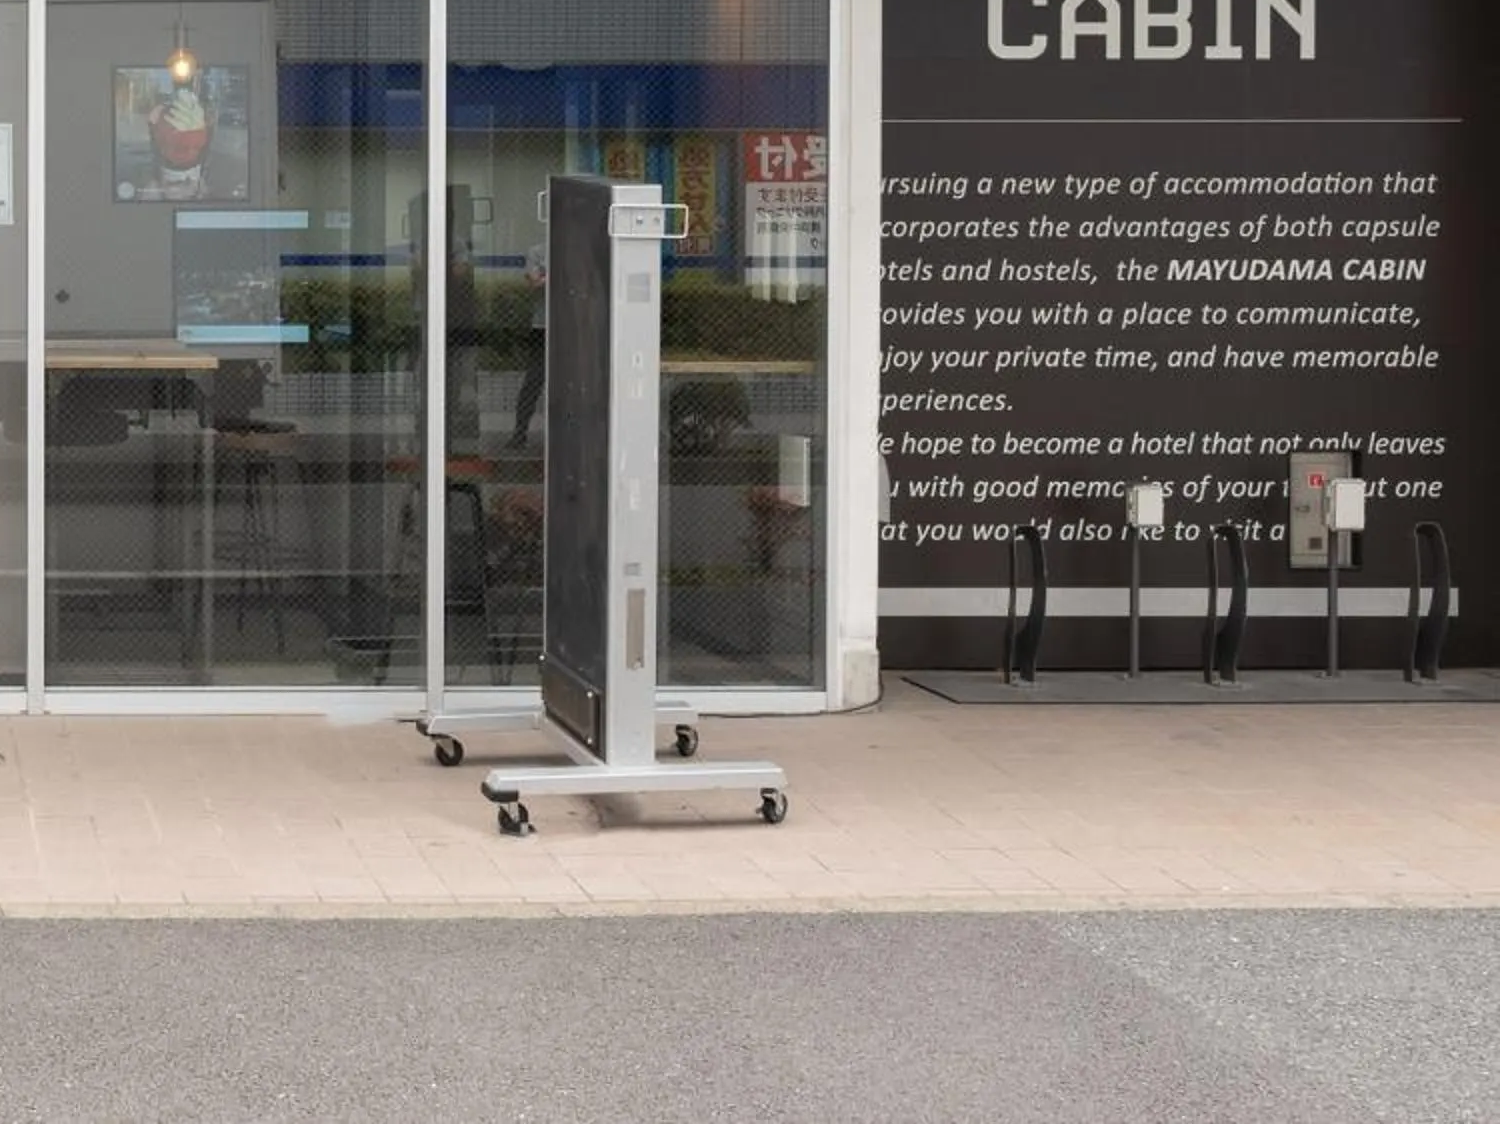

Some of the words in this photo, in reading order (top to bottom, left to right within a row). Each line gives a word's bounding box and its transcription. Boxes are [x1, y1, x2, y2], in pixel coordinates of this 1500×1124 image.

[881, 173, 968, 200] rsuing
[978, 178, 992, 195] a
[1002, 178, 1057, 195] new
[1065, 175, 1121, 200] type
[1130, 172, 1159, 200] of
[1164, 172, 1373, 195] accommodation
[1383, 172, 1437, 195] that
[881, 217, 1019, 242] corporates
[1029, 215, 1070, 238] the
[1079, 215, 1231, 242] advantages
[1239, 215, 1268, 242] of
[1273, 215, 1332, 238] both
[1342, 215, 1441, 242] capsule
[880, 258, 933, 282] tels
[942, 258, 991, 282] and
[1000, 258, 1098, 284] hostels,
[1117, 258, 1159, 282] the
[1166, 259, 1333, 282] MAYUDAMA
[1343, 259, 1427, 282] CABIN
[881, 302, 966, 325] ovides
[974, 308, 1022, 330] you
[1032, 302, 1088, 325] with
[1098, 308, 1113, 325] a
[1121, 302, 1193, 330] place
[1202, 304, 1228, 325] to
[1236, 302, 1421, 328] communicate,
[880, 346, 924, 373] joy
[930, 351, 989, 373] your
[995, 345, 1087, 373] private
[1095, 345, 1158, 372] time,
[1167, 345, 1217, 368] and
[1224, 345, 1285, 368] have
[1292, 345, 1439, 368] memorable
[881, 389, 1013, 416] periences.
[878, 433, 895, 455] e
[902, 432, 964, 459] hope
[972, 433, 997, 455] to
[1004, 431, 1101, 455] become
[1108, 437, 1124, 455] a
[1131, 432, 1194, 455] hotel
[1202, 432, 1253, 455] that
[1260, 434, 1302, 455] not
[1368, 432, 1446, 455] leaves
[909, 475, 965, 498] with
[973, 475, 1040, 503] good
[1183, 475, 1213, 503] of
[1216, 480, 1276, 503] your
[1395, 481, 1443, 498] one
[881, 521, 909, 541] at
[916, 524, 963, 546] you
[1060, 518, 1113, 541] also
[1174, 521, 1201, 541] to
